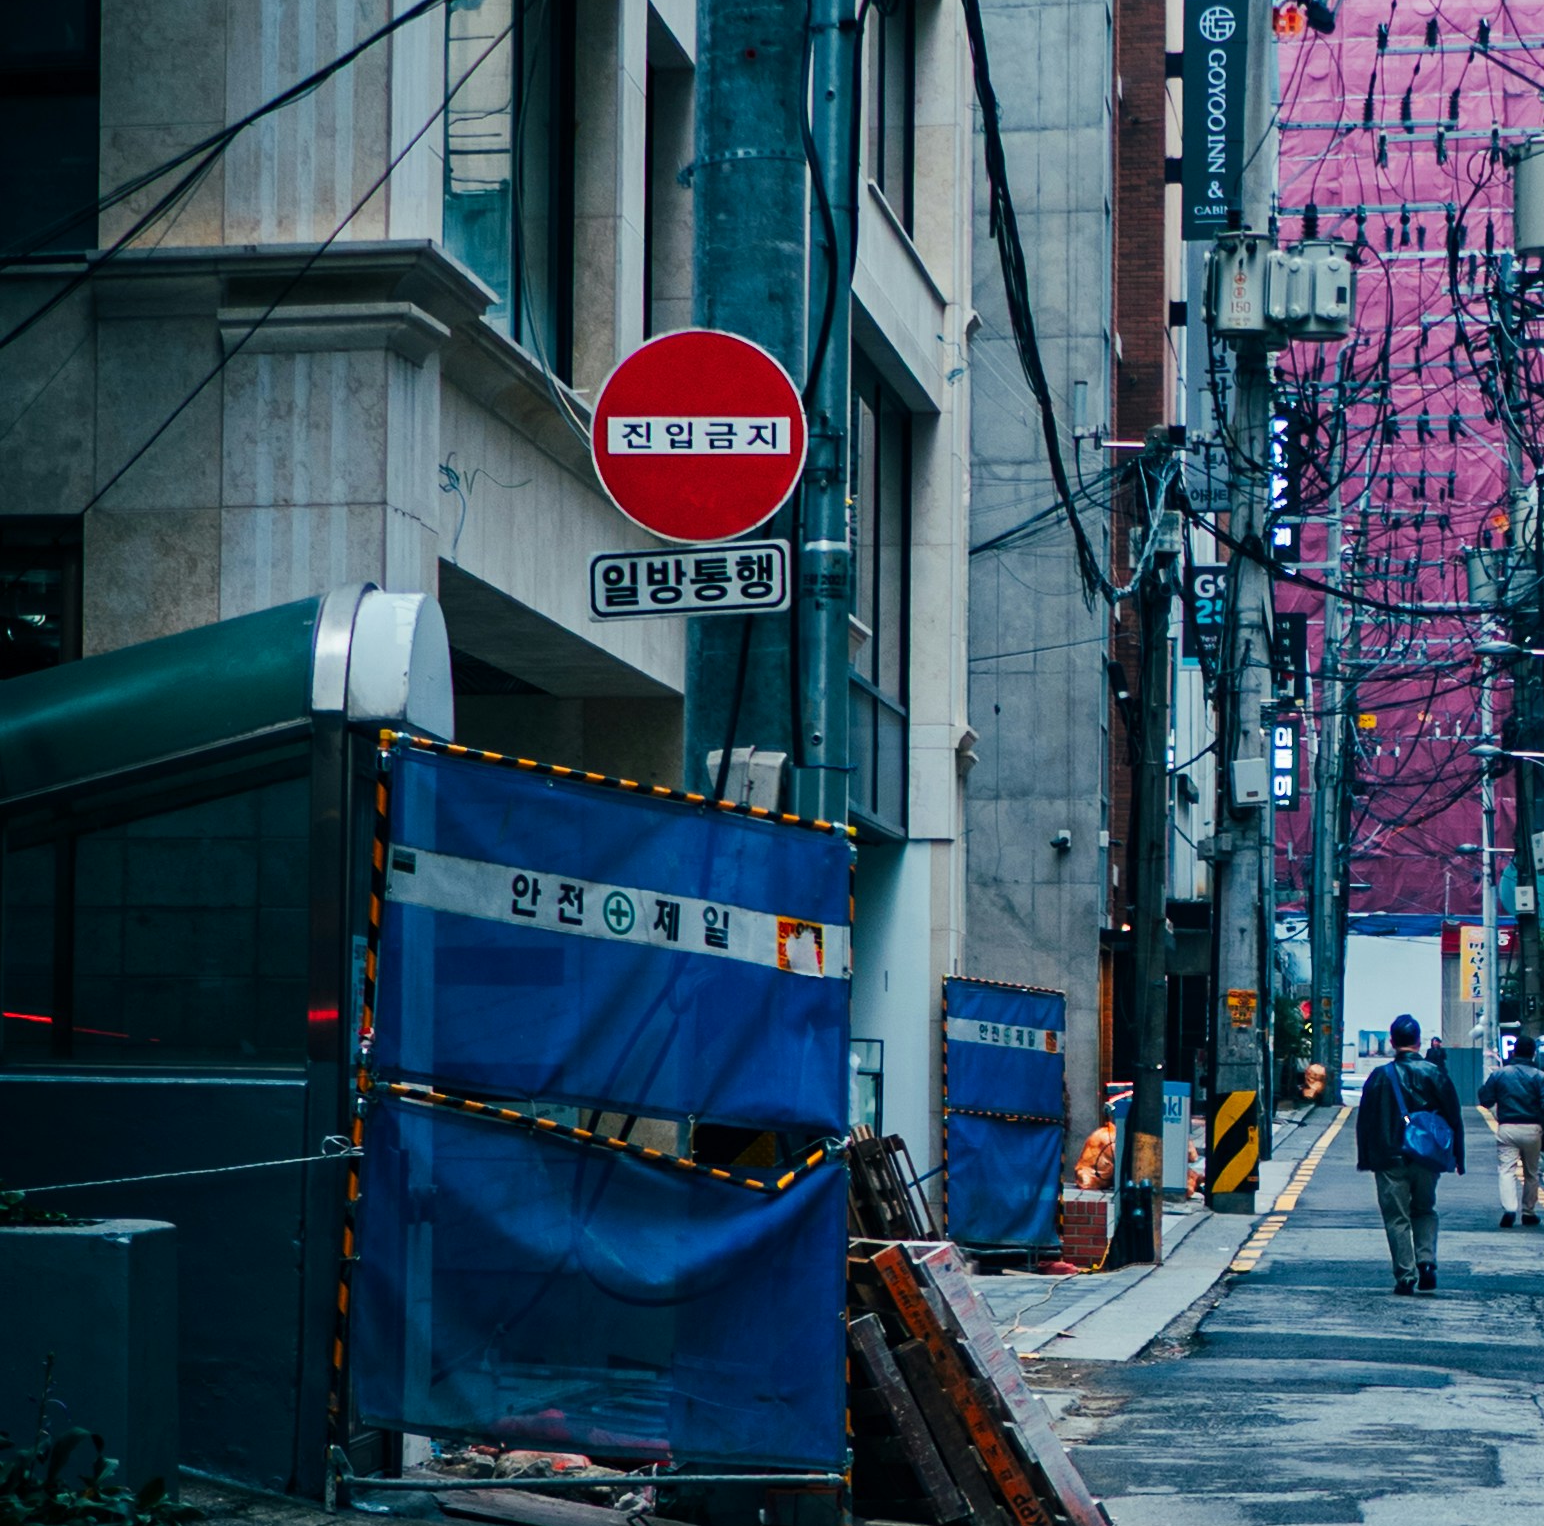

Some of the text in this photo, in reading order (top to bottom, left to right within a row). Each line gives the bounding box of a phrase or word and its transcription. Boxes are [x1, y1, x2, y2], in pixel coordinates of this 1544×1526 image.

[1207, 48, 1227, 199] GOYOO INN &
[621, 421, 777, 451] 진입금지
[602, 553, 774, 607] 일방통행
[511, 873, 585, 926] 안전
[653, 898, 730, 951] 제일
